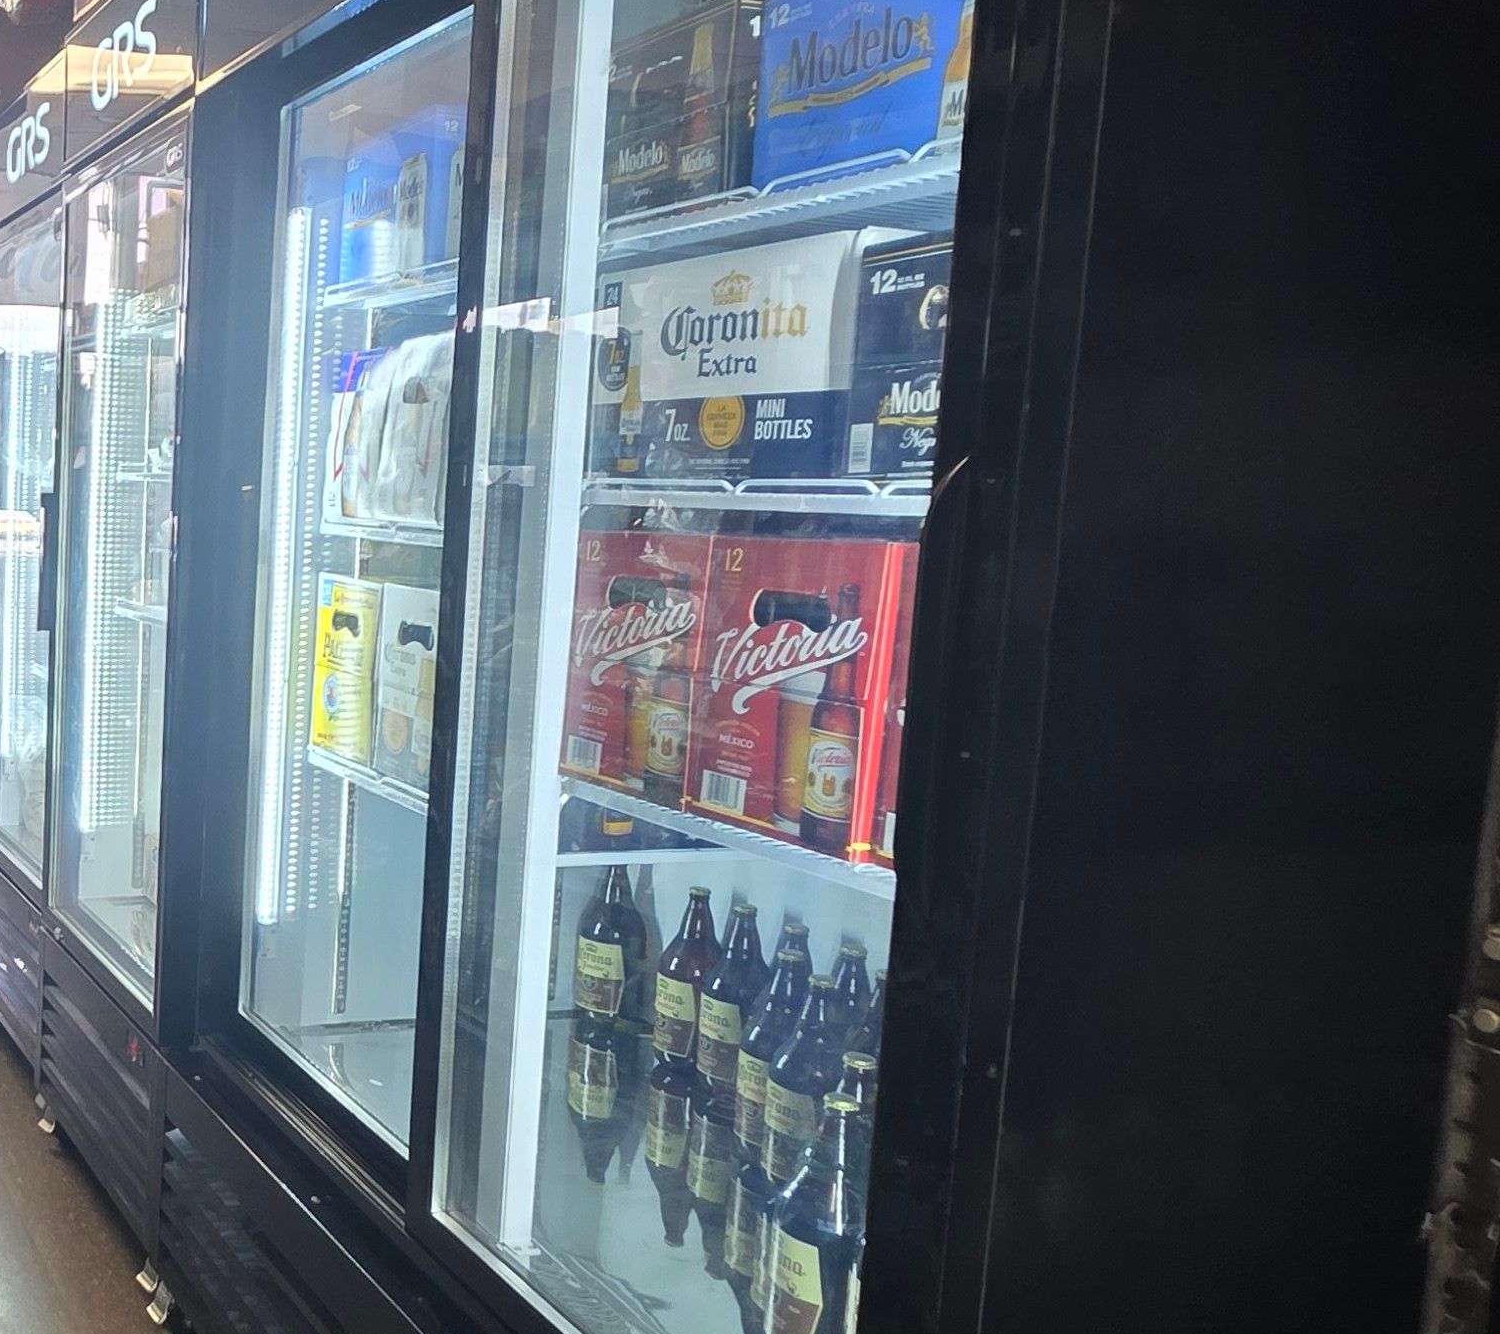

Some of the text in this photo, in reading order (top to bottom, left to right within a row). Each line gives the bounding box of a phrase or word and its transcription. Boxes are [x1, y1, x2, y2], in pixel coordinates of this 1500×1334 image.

[770, 2, 790, 29] 12
[786, 5, 914, 96] Modelo
[6, 101, 50, 184] GRS
[618, 140, 663, 177] Modelo
[605, 286, 620, 306] 24
[870, 269, 897, 295] 12
[660, 297, 808, 361] Coronita
[696, 347, 758, 379] Extra
[756, 398, 786, 419] MINI
[754, 419, 813, 441] BOTTLES
[586, 539, 601, 563] 12
[725, 547, 745, 573] 12
[575, 600, 696, 673] Victoria
[710, 615, 868, 697] Victoria
